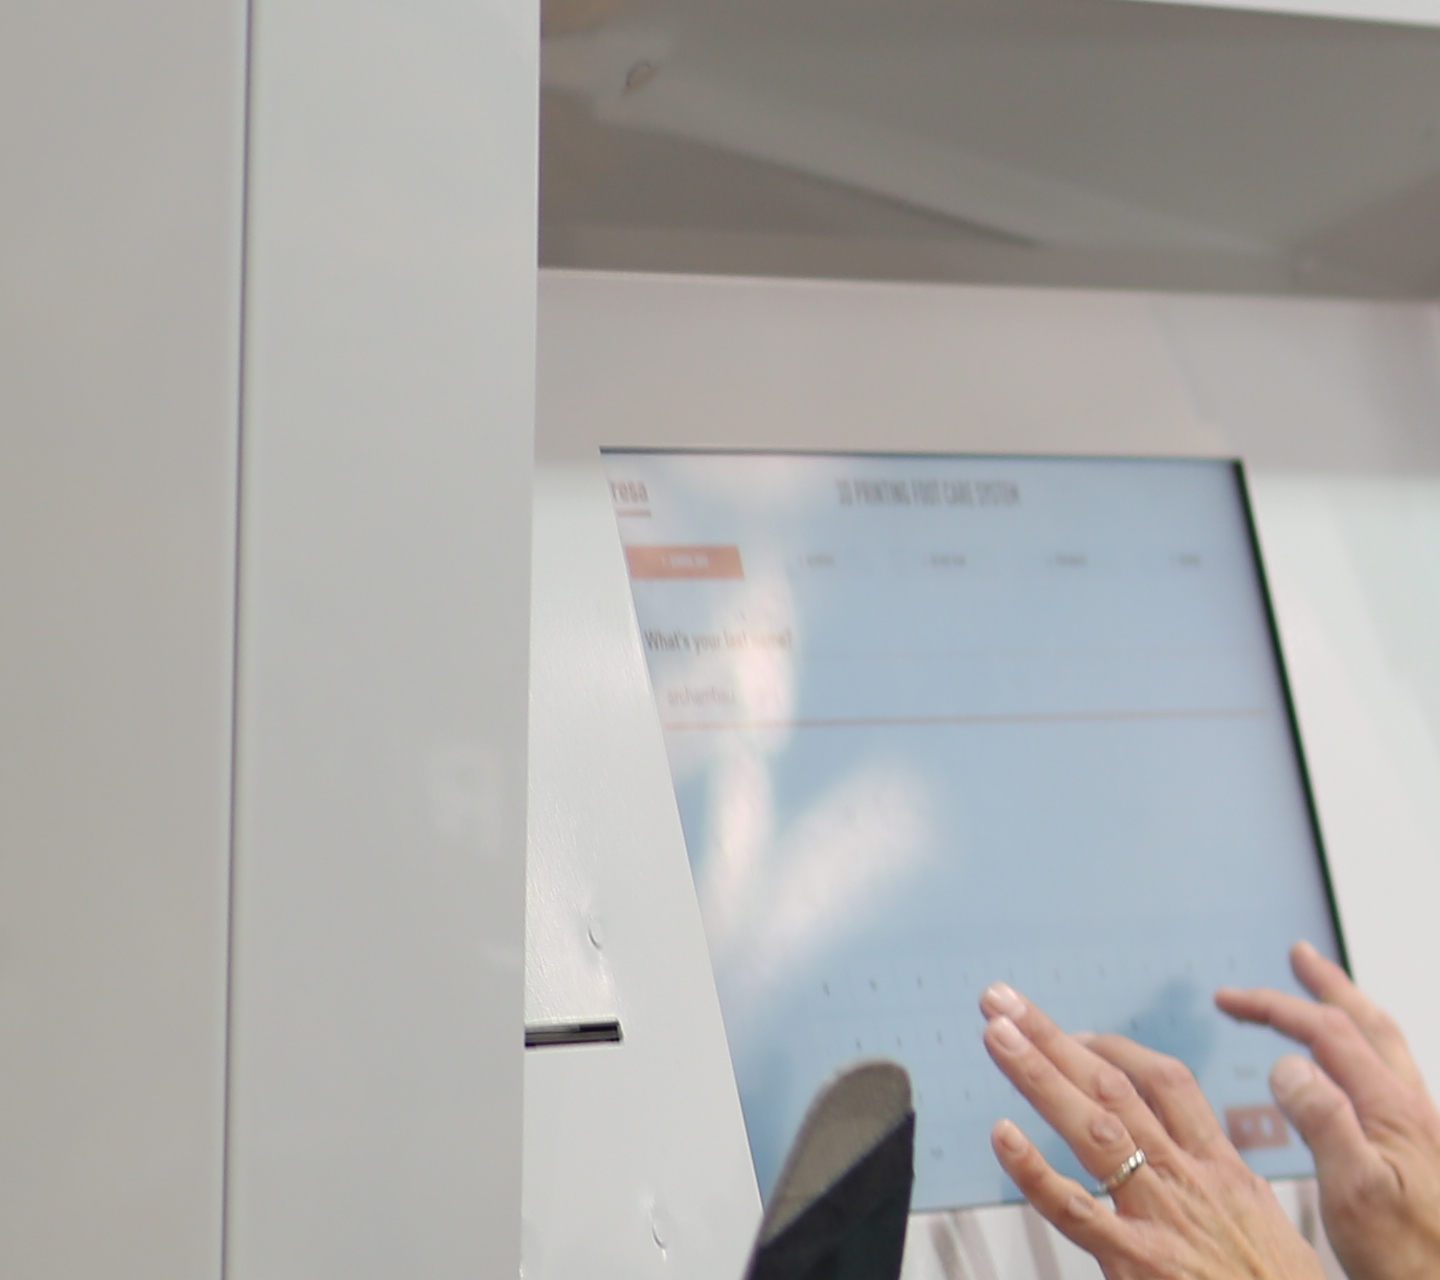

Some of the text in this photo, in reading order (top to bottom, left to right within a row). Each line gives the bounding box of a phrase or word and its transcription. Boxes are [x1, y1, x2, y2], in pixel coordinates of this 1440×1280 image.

[611, 480, 649, 504] resa
[643, 628, 691, 651] What's
[692, 634, 721, 656] your
[722, 629, 748, 649] last
